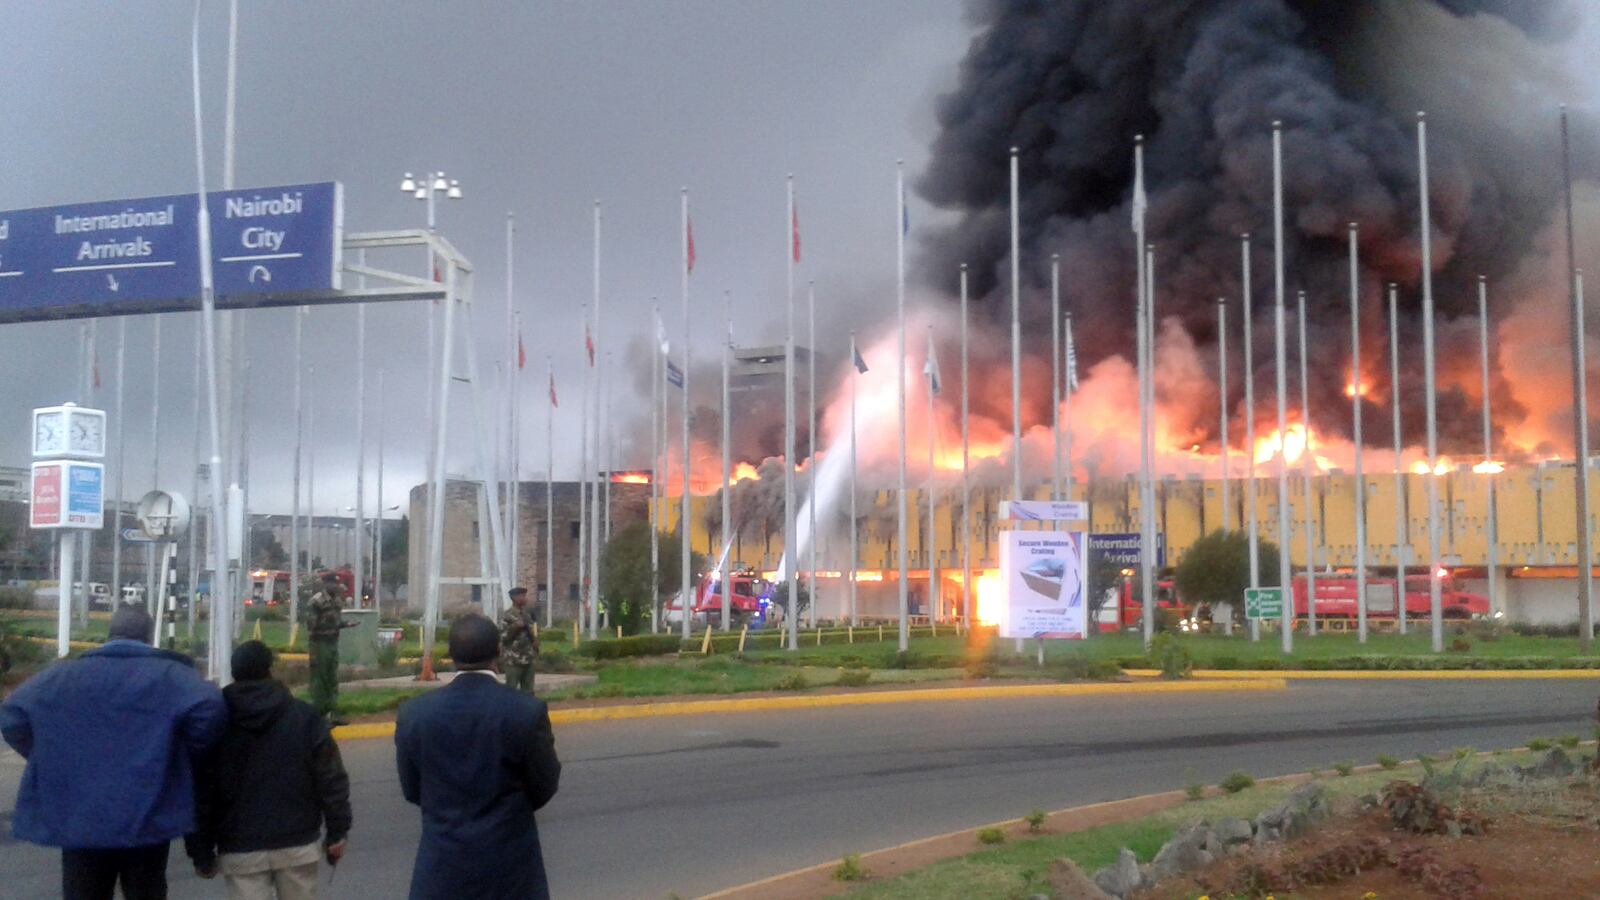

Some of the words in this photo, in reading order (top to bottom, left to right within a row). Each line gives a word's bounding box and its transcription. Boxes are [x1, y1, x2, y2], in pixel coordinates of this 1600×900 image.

[225, 192, 303, 219] Nairobi
[55, 204, 174, 234] International
[77, 236, 153, 261] Arrivals
[242, 227, 286, 251] City
[1104, 550, 1141, 563] Arrival
